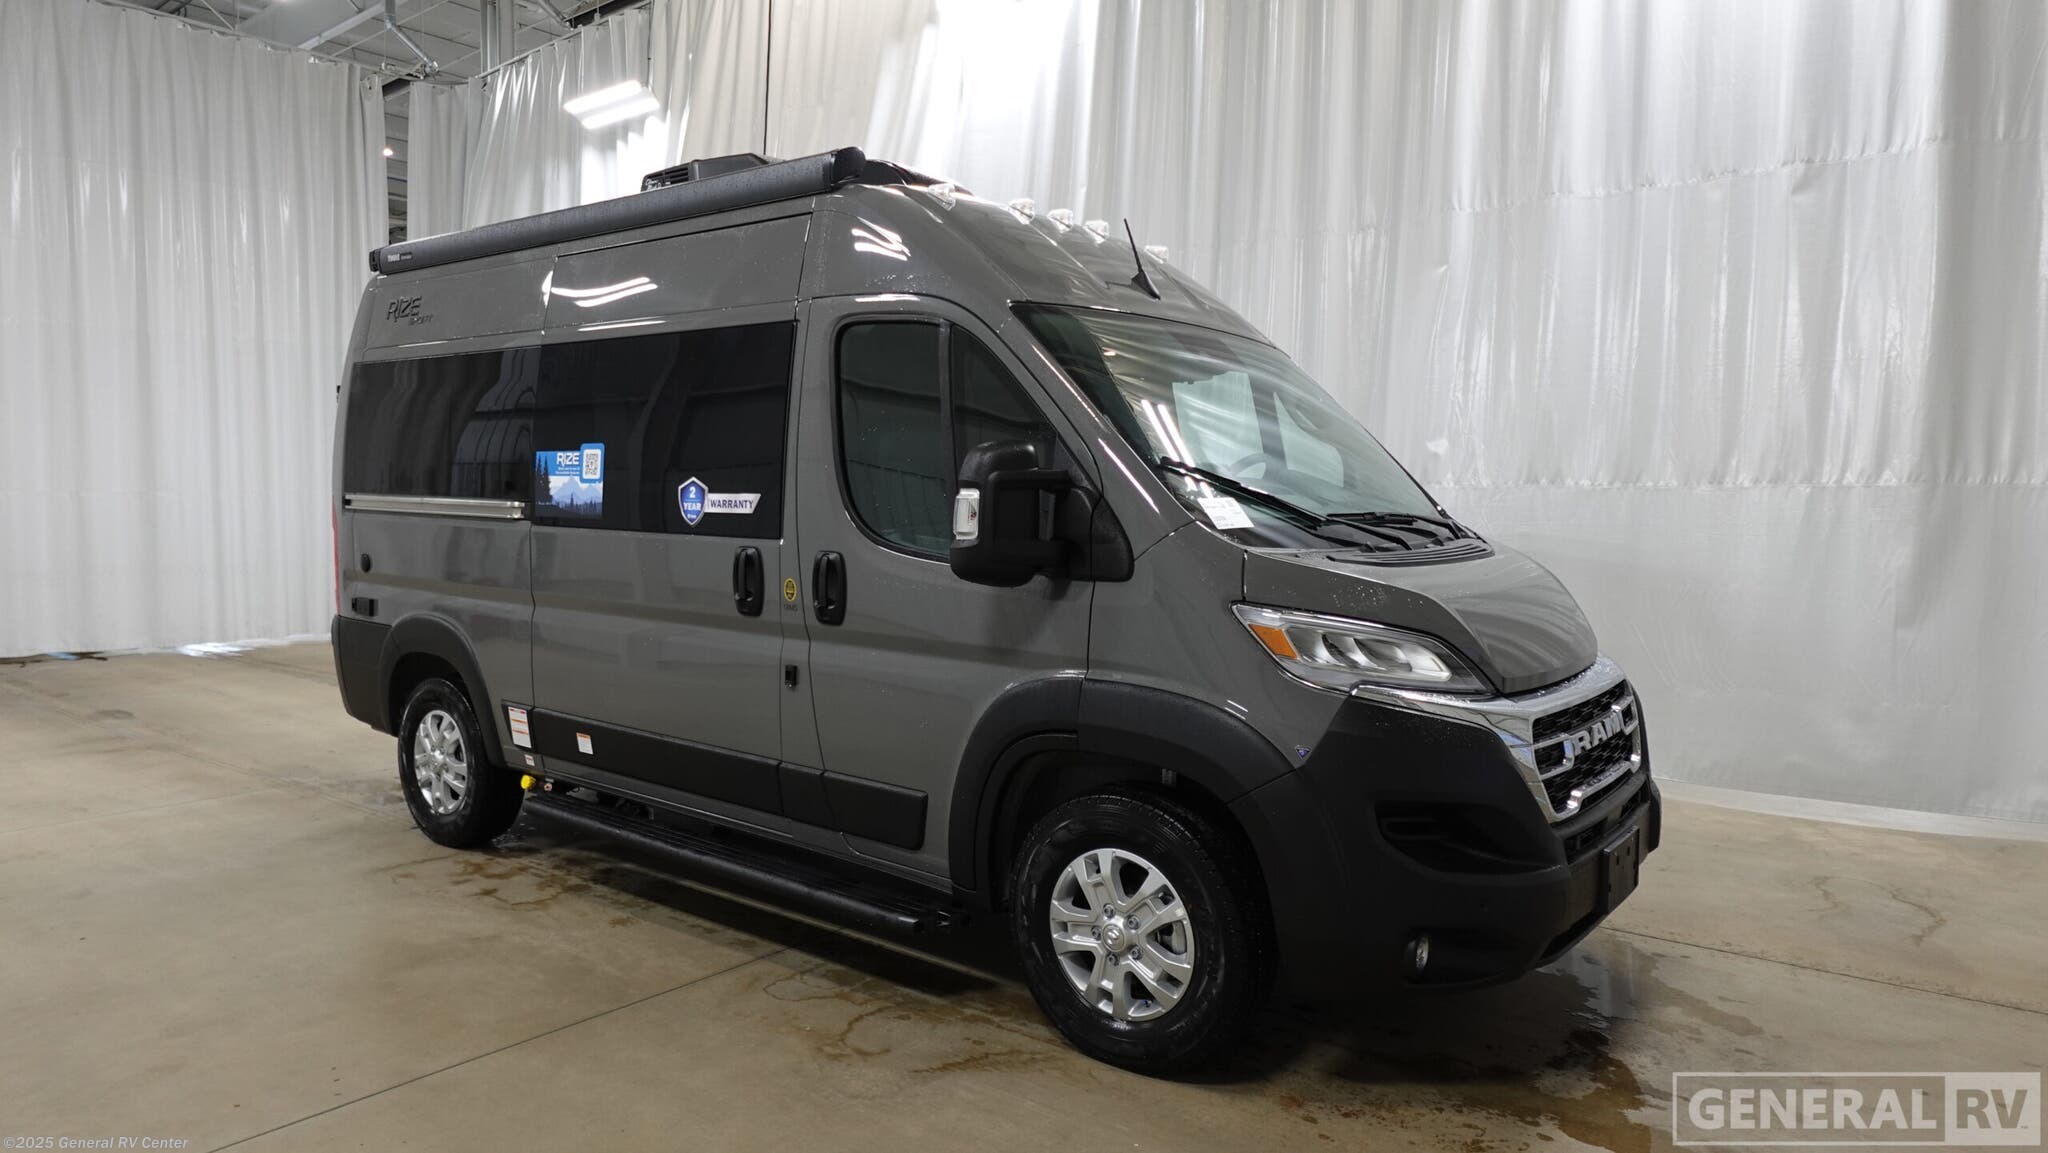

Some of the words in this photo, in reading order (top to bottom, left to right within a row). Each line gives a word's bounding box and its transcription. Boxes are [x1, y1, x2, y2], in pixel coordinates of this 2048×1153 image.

[386, 296, 422, 323] RIZE
[556, 452, 580, 467] RIZE
[689, 486, 697, 499] 2
[683, 502, 702, 511] YEAR
[710, 499, 754, 509] WARRANTY
[1571, 711, 1622, 757] RAM
